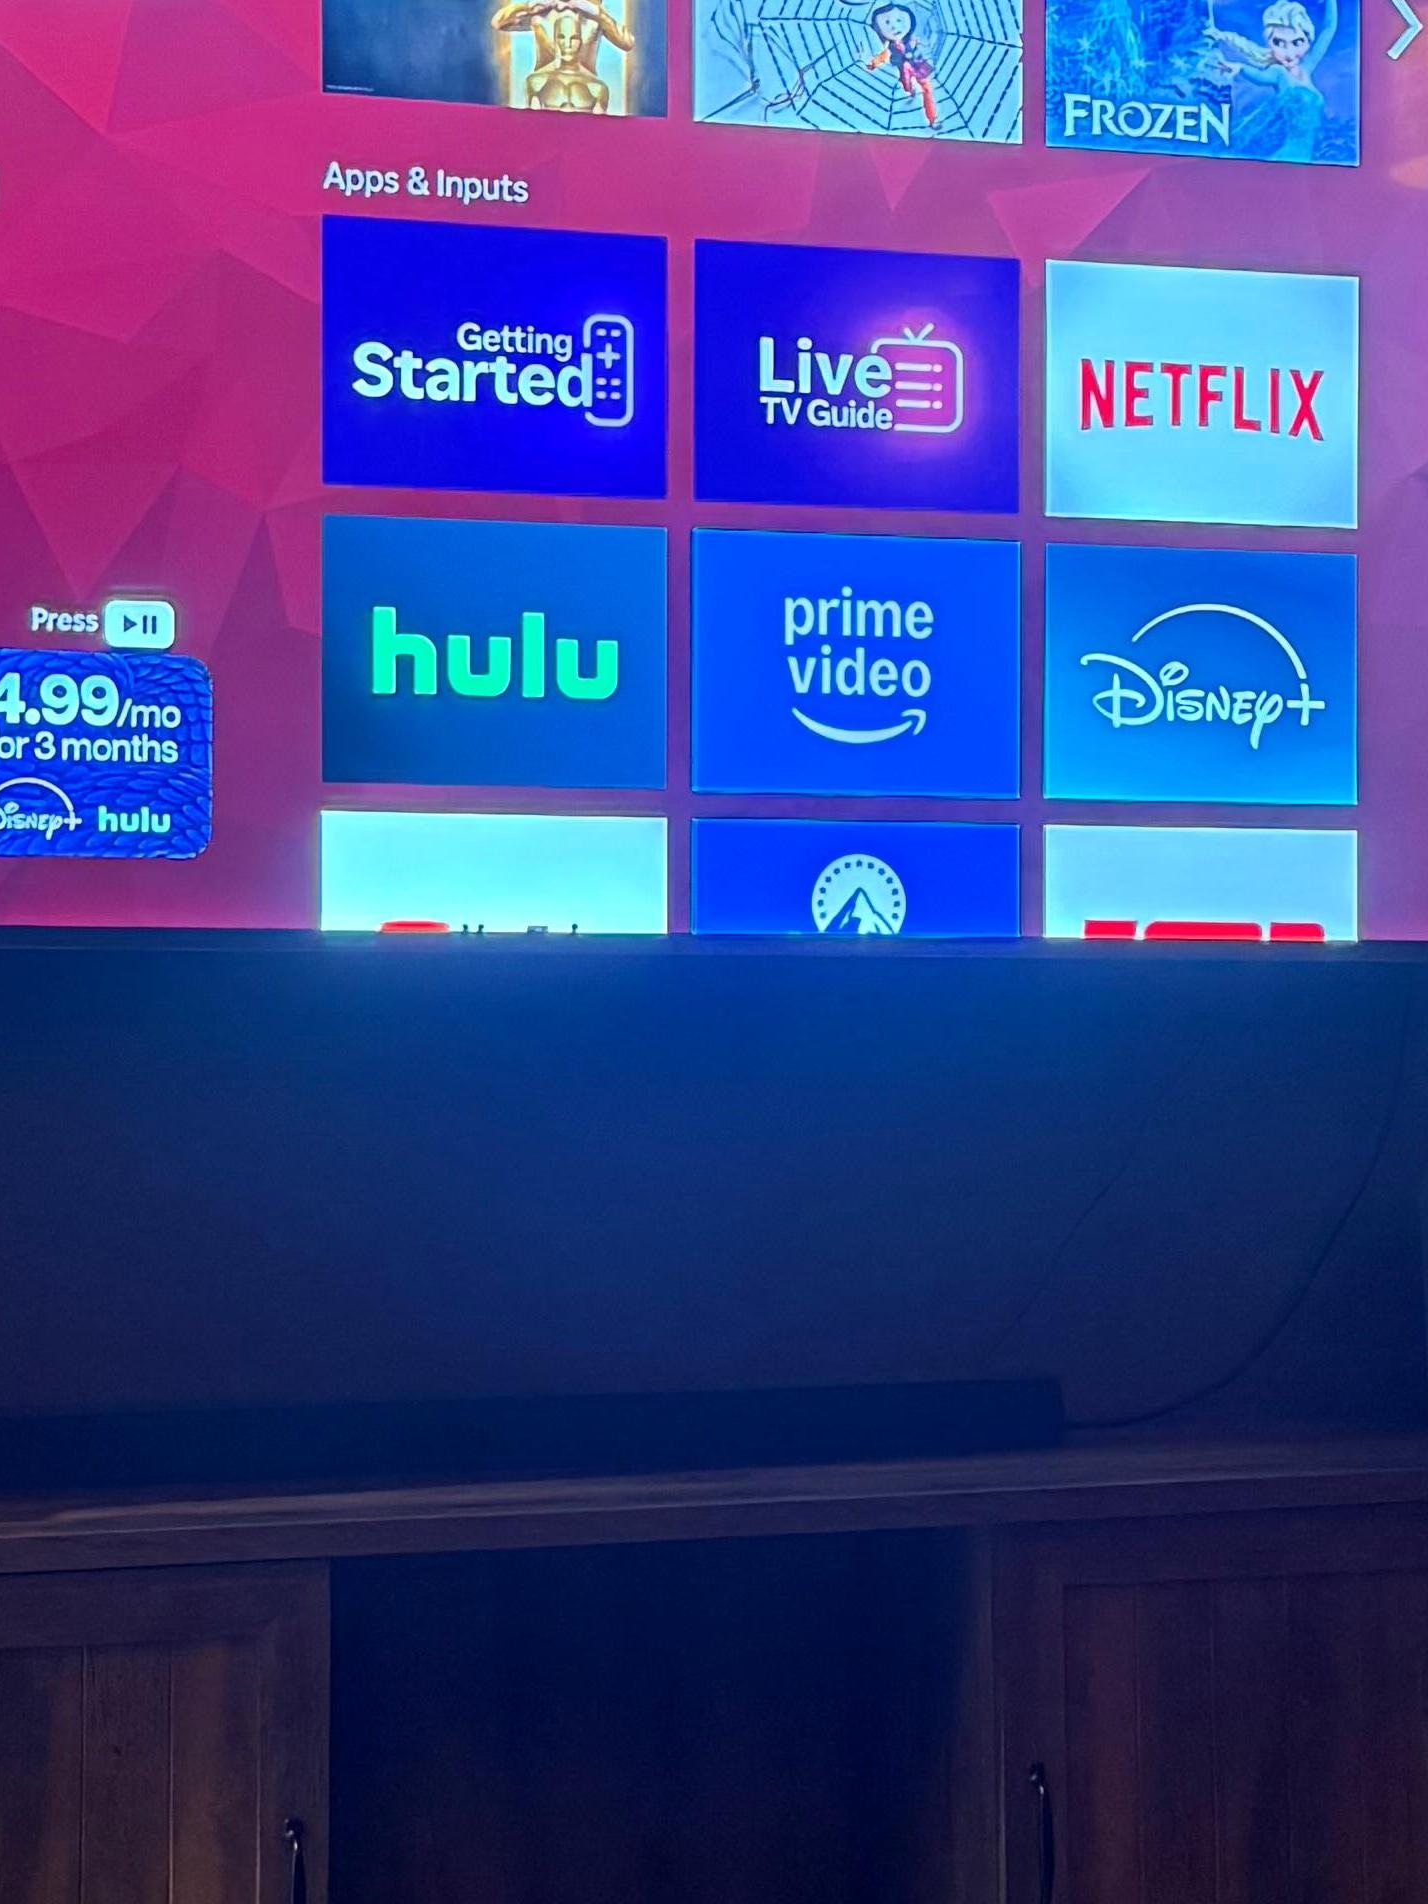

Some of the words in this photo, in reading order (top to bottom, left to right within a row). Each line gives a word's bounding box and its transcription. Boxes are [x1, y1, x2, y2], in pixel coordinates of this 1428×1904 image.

[1062, 94, 1232, 147] FROZEN
[322, 161, 400, 199] Apps
[406, 167, 429, 197] &
[436, 169, 530, 203] Inputs
[456, 322, 573, 359] Getting
[759, 336, 893, 398] Live
[352, 342, 593, 410] Started
[1079, 357, 1325, 441] NETFLIX
[760, 396, 802, 427] TV
[806, 399, 894, 429] Guide
[30, 605, 99, 635] Press
[783, 586, 935, 646] prime
[372, 605, 619, 700] hulu
[787, 644, 932, 698] video
[33, 731, 56, 761] 3
[61, 733, 179, 764] months
[97, 804, 172, 833] hulu
